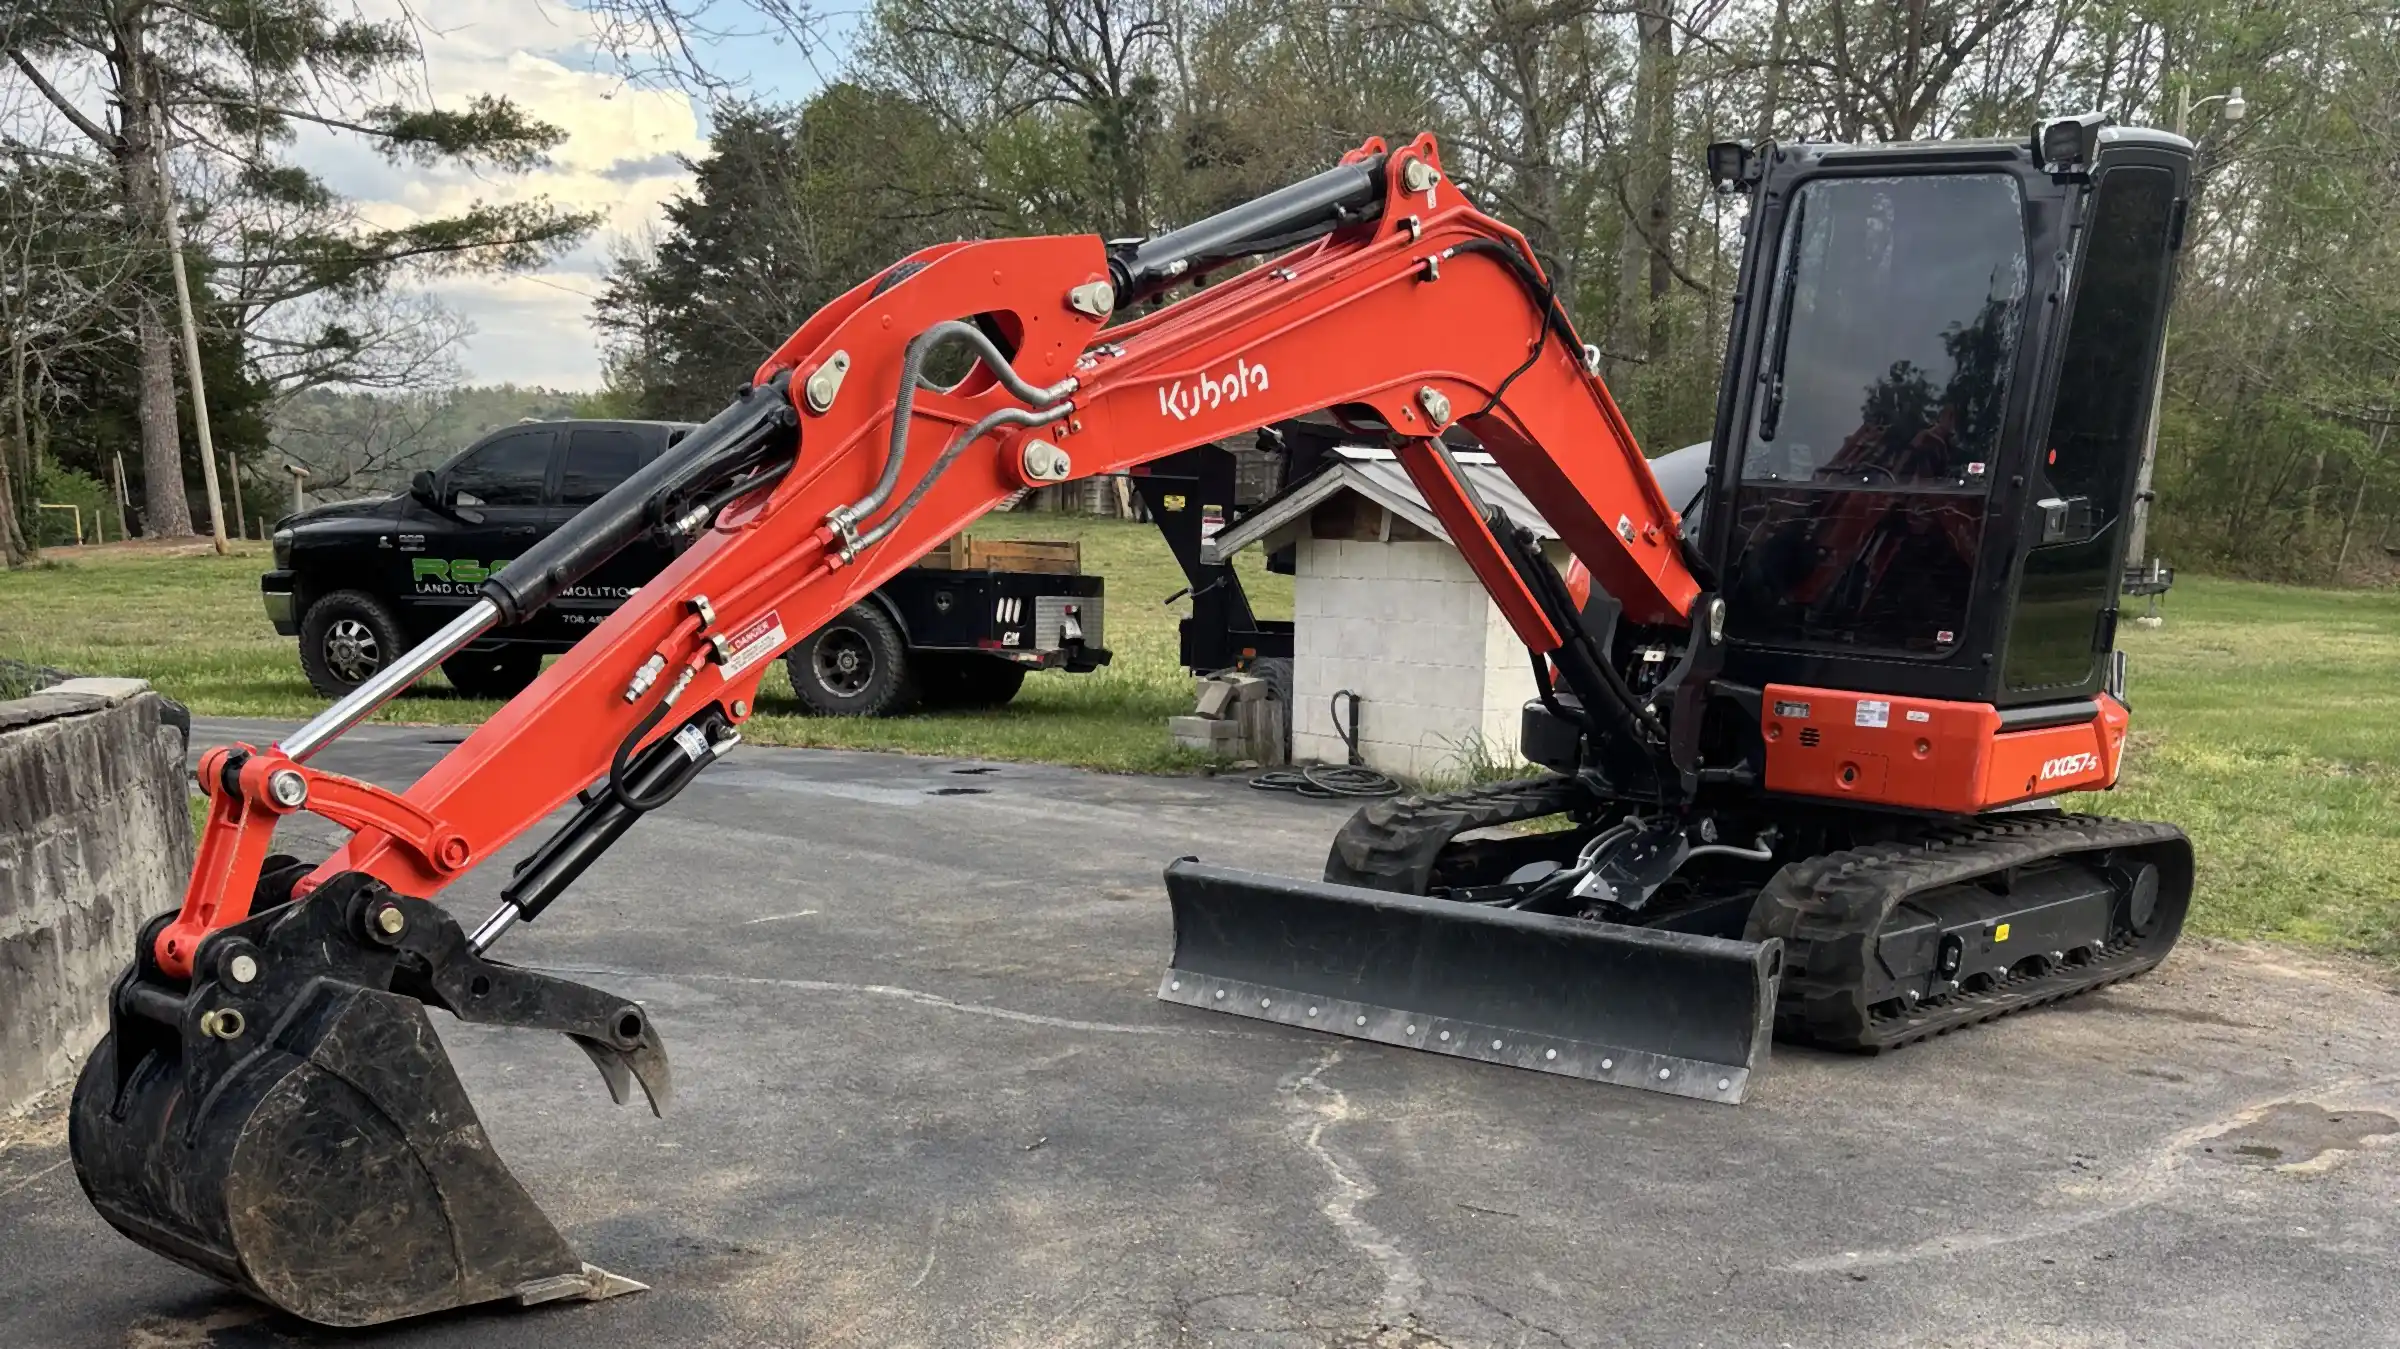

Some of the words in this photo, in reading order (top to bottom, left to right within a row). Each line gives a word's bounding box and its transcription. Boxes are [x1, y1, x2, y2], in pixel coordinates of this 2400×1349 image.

[1159, 359, 1269, 421] Kubota
[415, 584, 452, 594] LAND
[558, 586, 629, 598] MOLITIO
